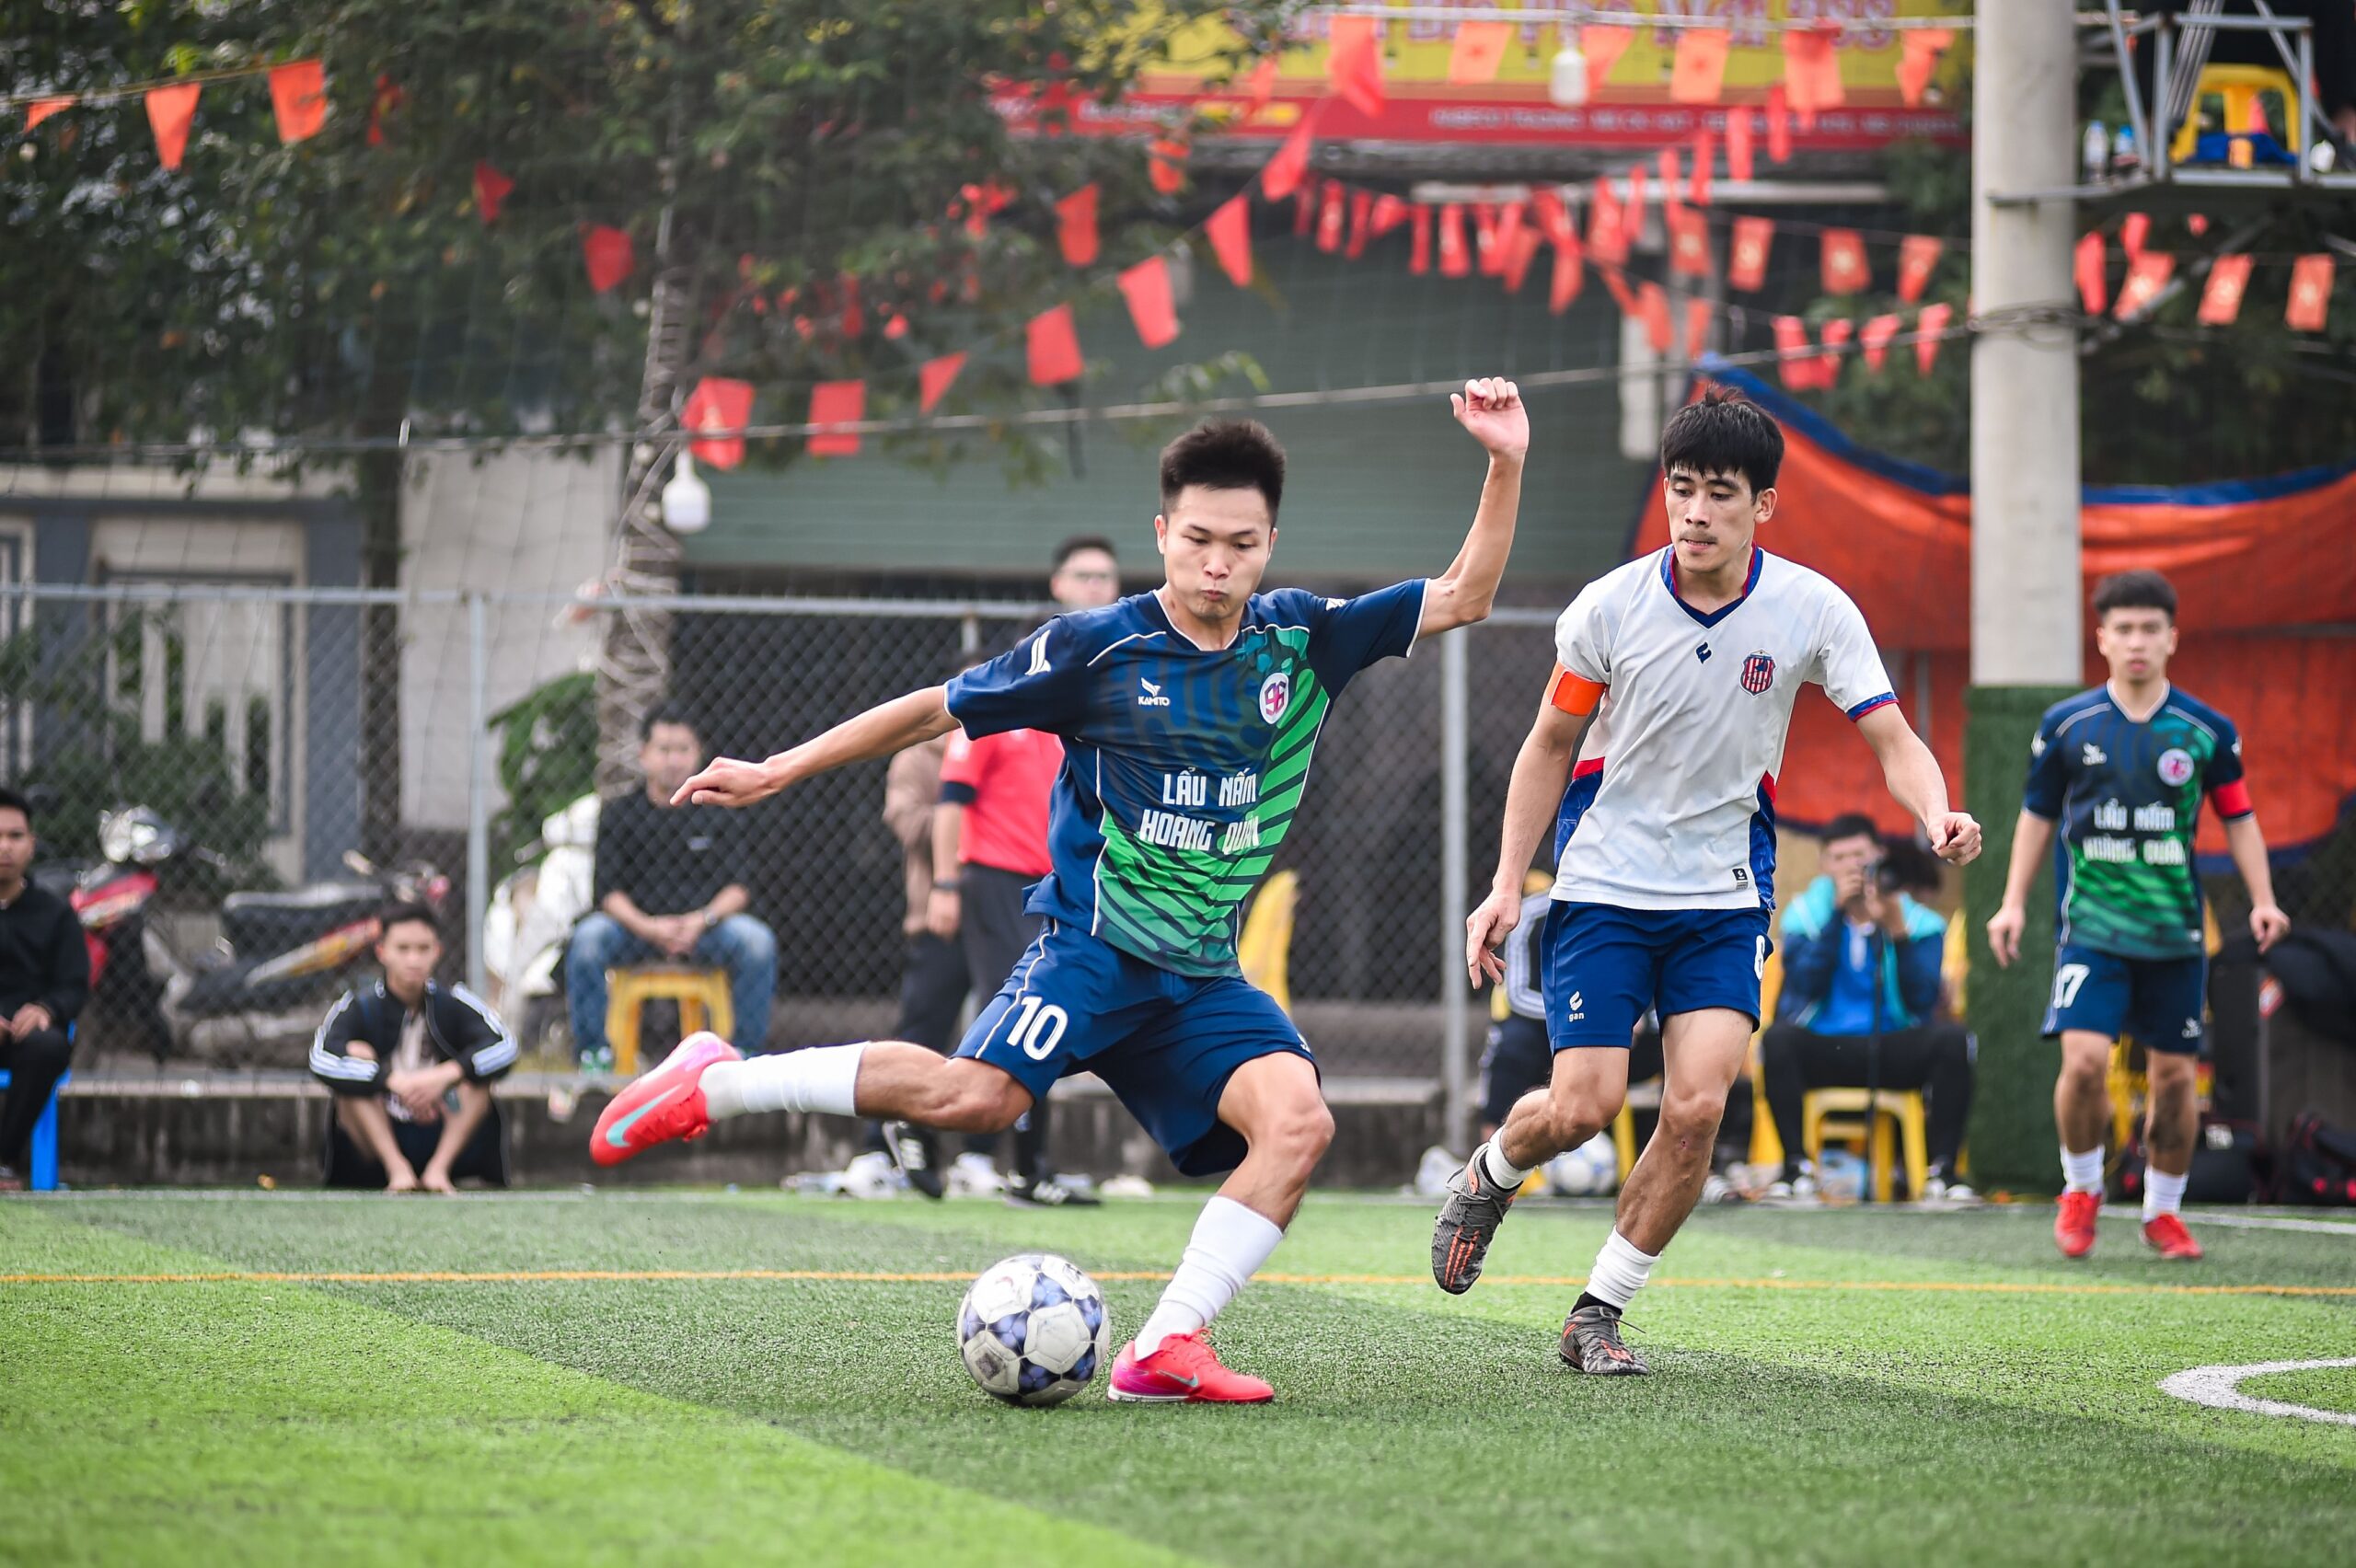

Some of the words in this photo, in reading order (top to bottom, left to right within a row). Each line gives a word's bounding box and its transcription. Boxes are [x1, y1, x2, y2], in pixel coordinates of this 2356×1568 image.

[1138, 696, 1170, 706] KAMITO
[1162, 767, 1207, 806] LẨU
[1218, 767, 1257, 806] NẤM
[1139, 809, 1215, 851] HOÀNG
[2053, 963, 2090, 1009] 17
[1006, 996, 1068, 1060] 10
[1568, 1012, 1584, 1022] gan
